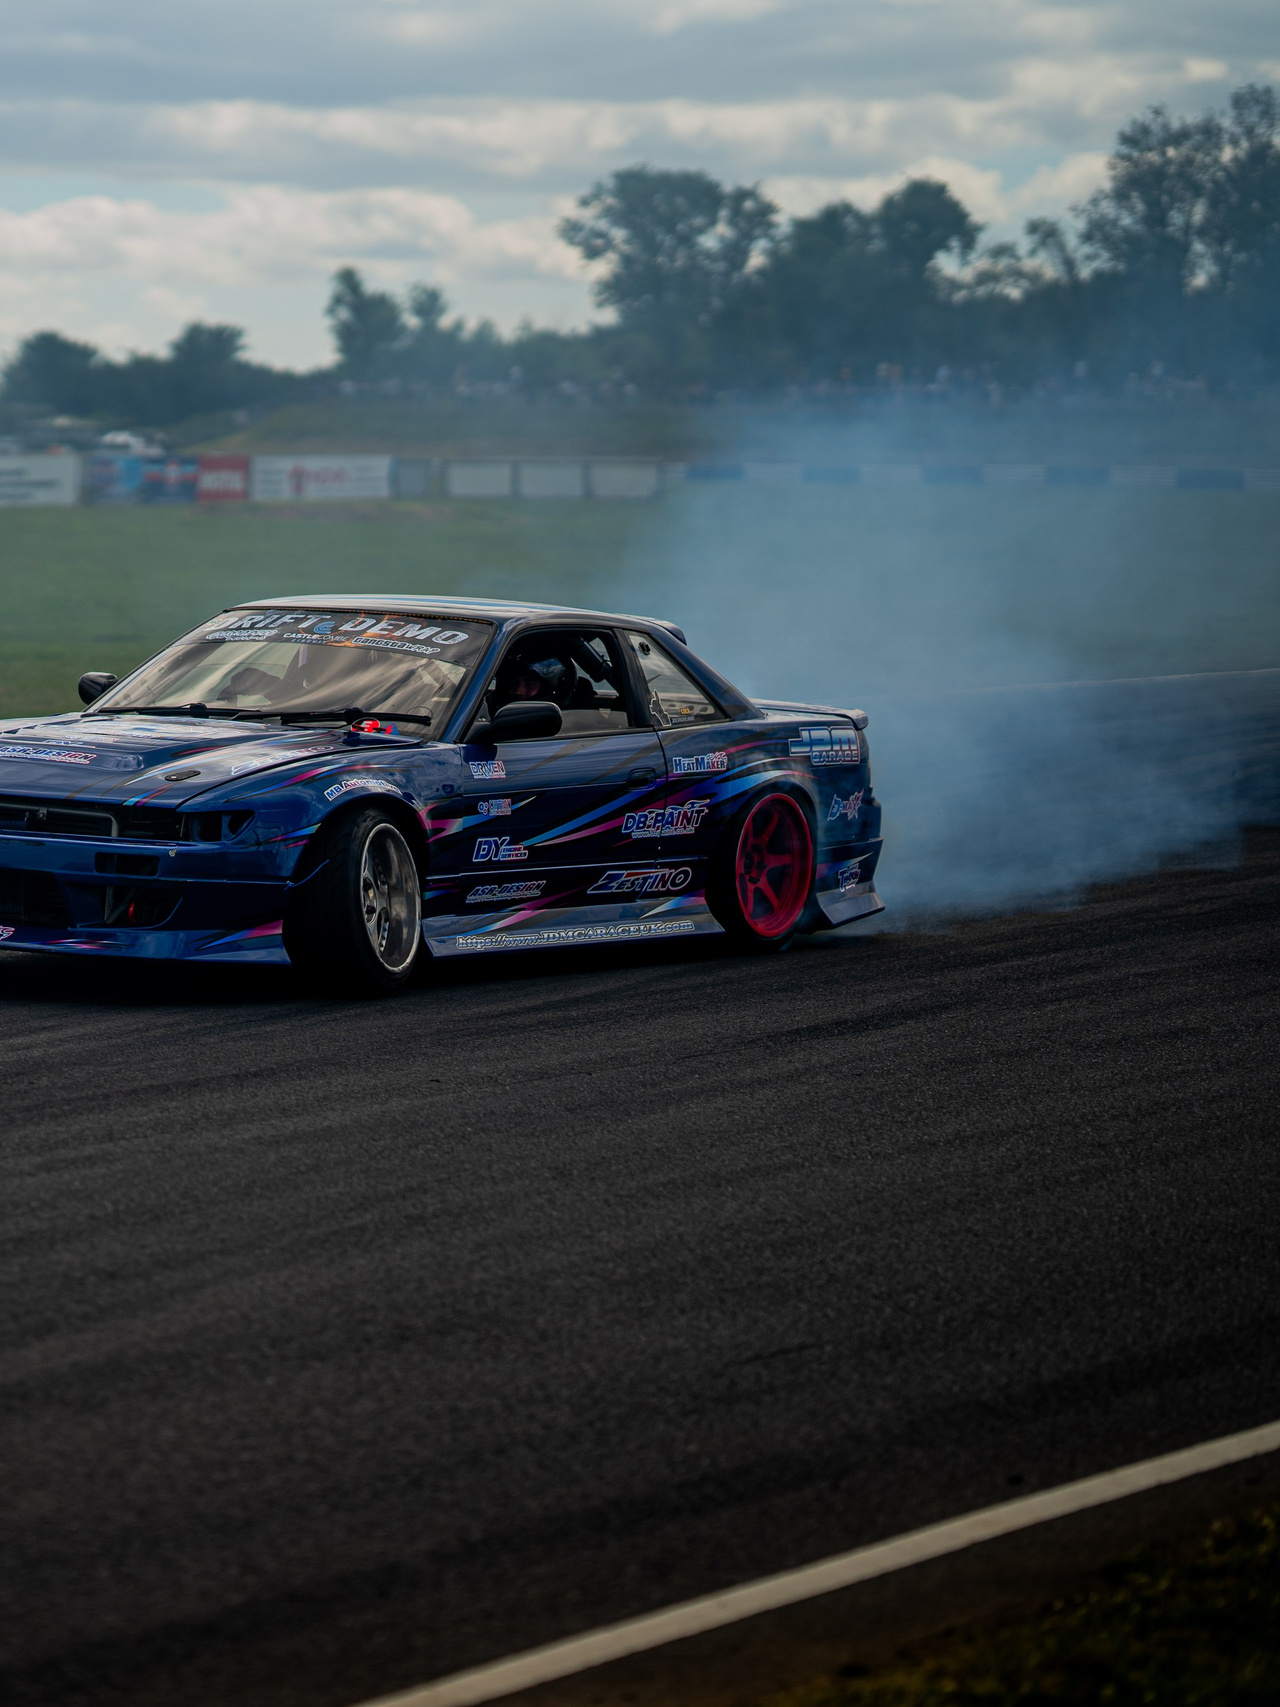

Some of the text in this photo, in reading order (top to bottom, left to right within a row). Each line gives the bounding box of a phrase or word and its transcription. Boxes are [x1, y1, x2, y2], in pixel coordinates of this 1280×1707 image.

[204, 614, 469, 645] DRIFT DEMO
[811, 751, 859, 763] GARAGE
[325, 785, 342, 800] MB
[473, 837, 510, 862] DY
[467, 880, 546, 898] ASR-DESIGN
[587, 867, 692, 897] ZESTINO
